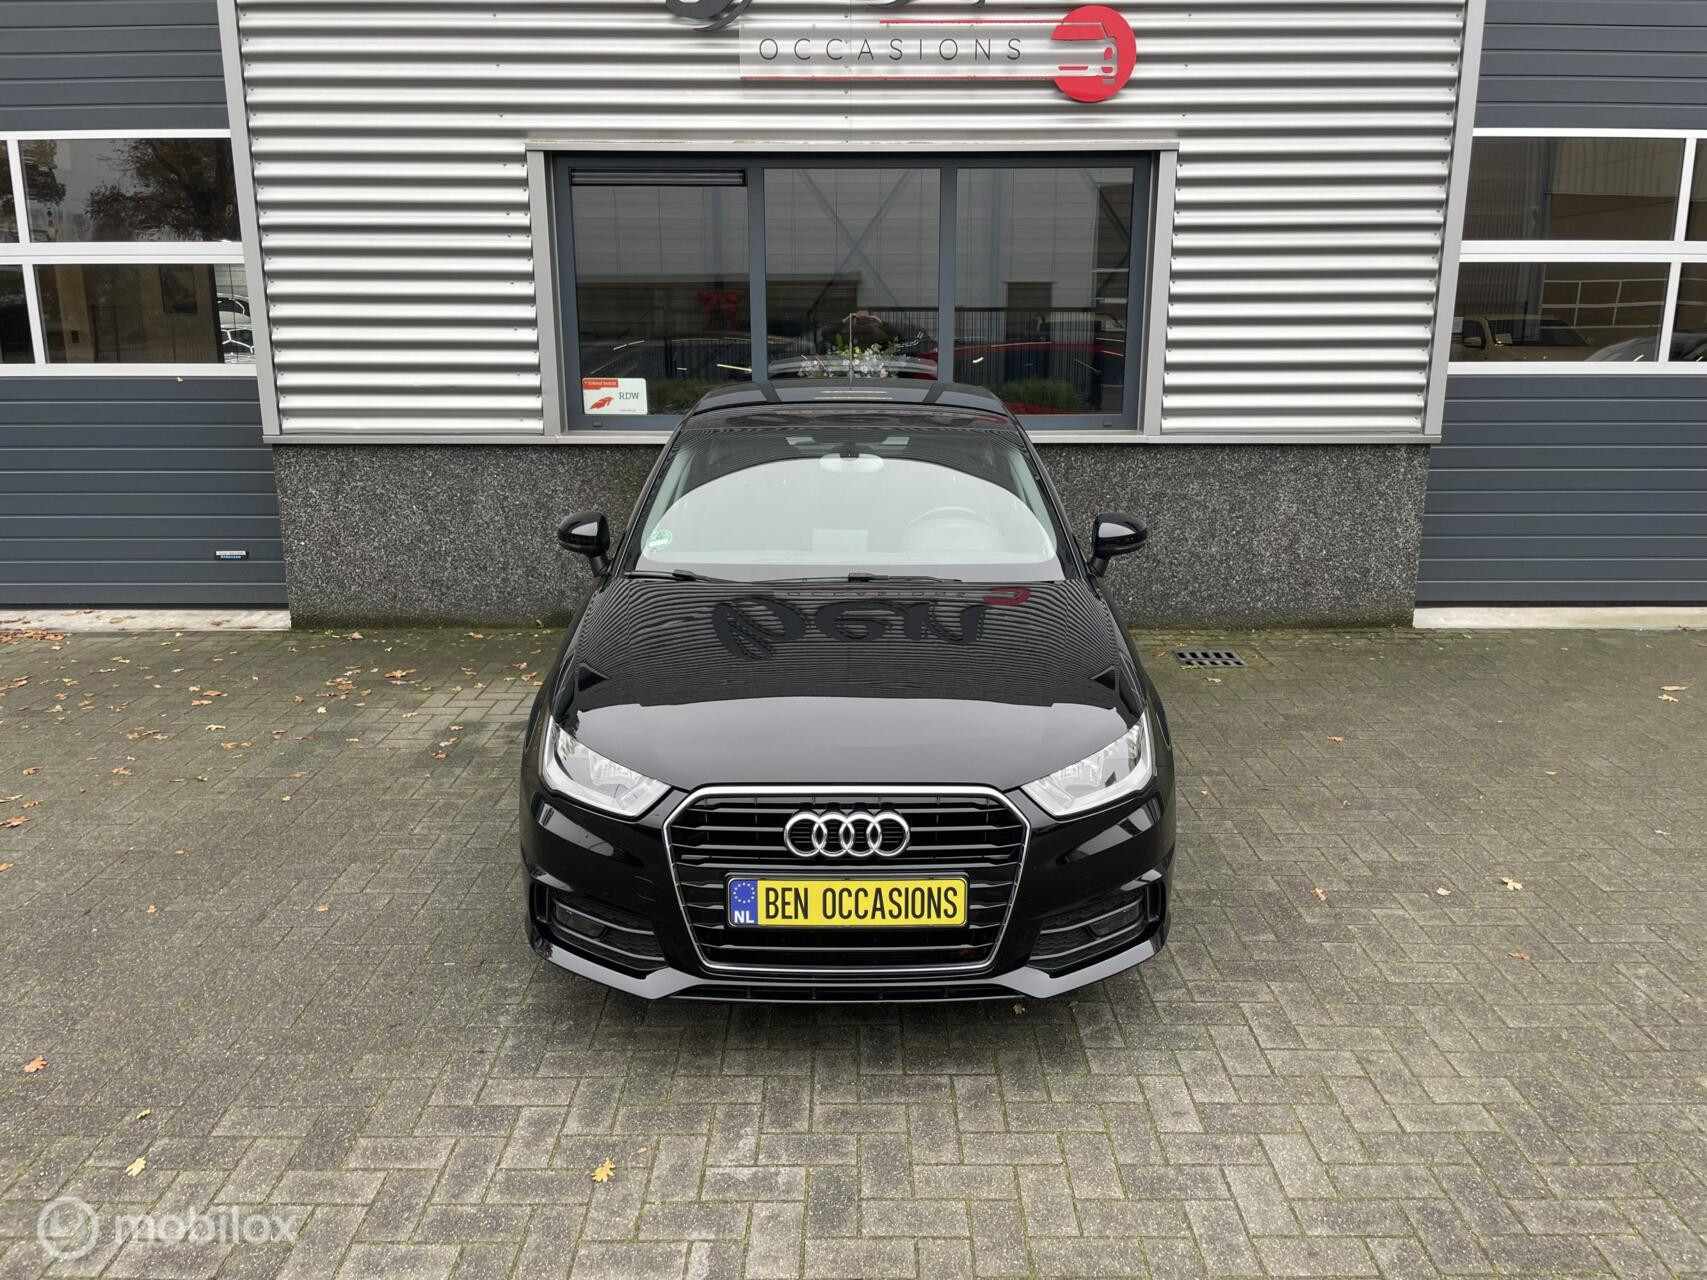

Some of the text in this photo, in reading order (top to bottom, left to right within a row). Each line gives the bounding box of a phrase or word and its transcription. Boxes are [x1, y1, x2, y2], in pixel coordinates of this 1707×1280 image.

[758, 37, 1024, 61] OCCASIONS
[619, 392, 640, 400] RDW
[734, 886, 958, 923] NL BEN OCCASIONS
